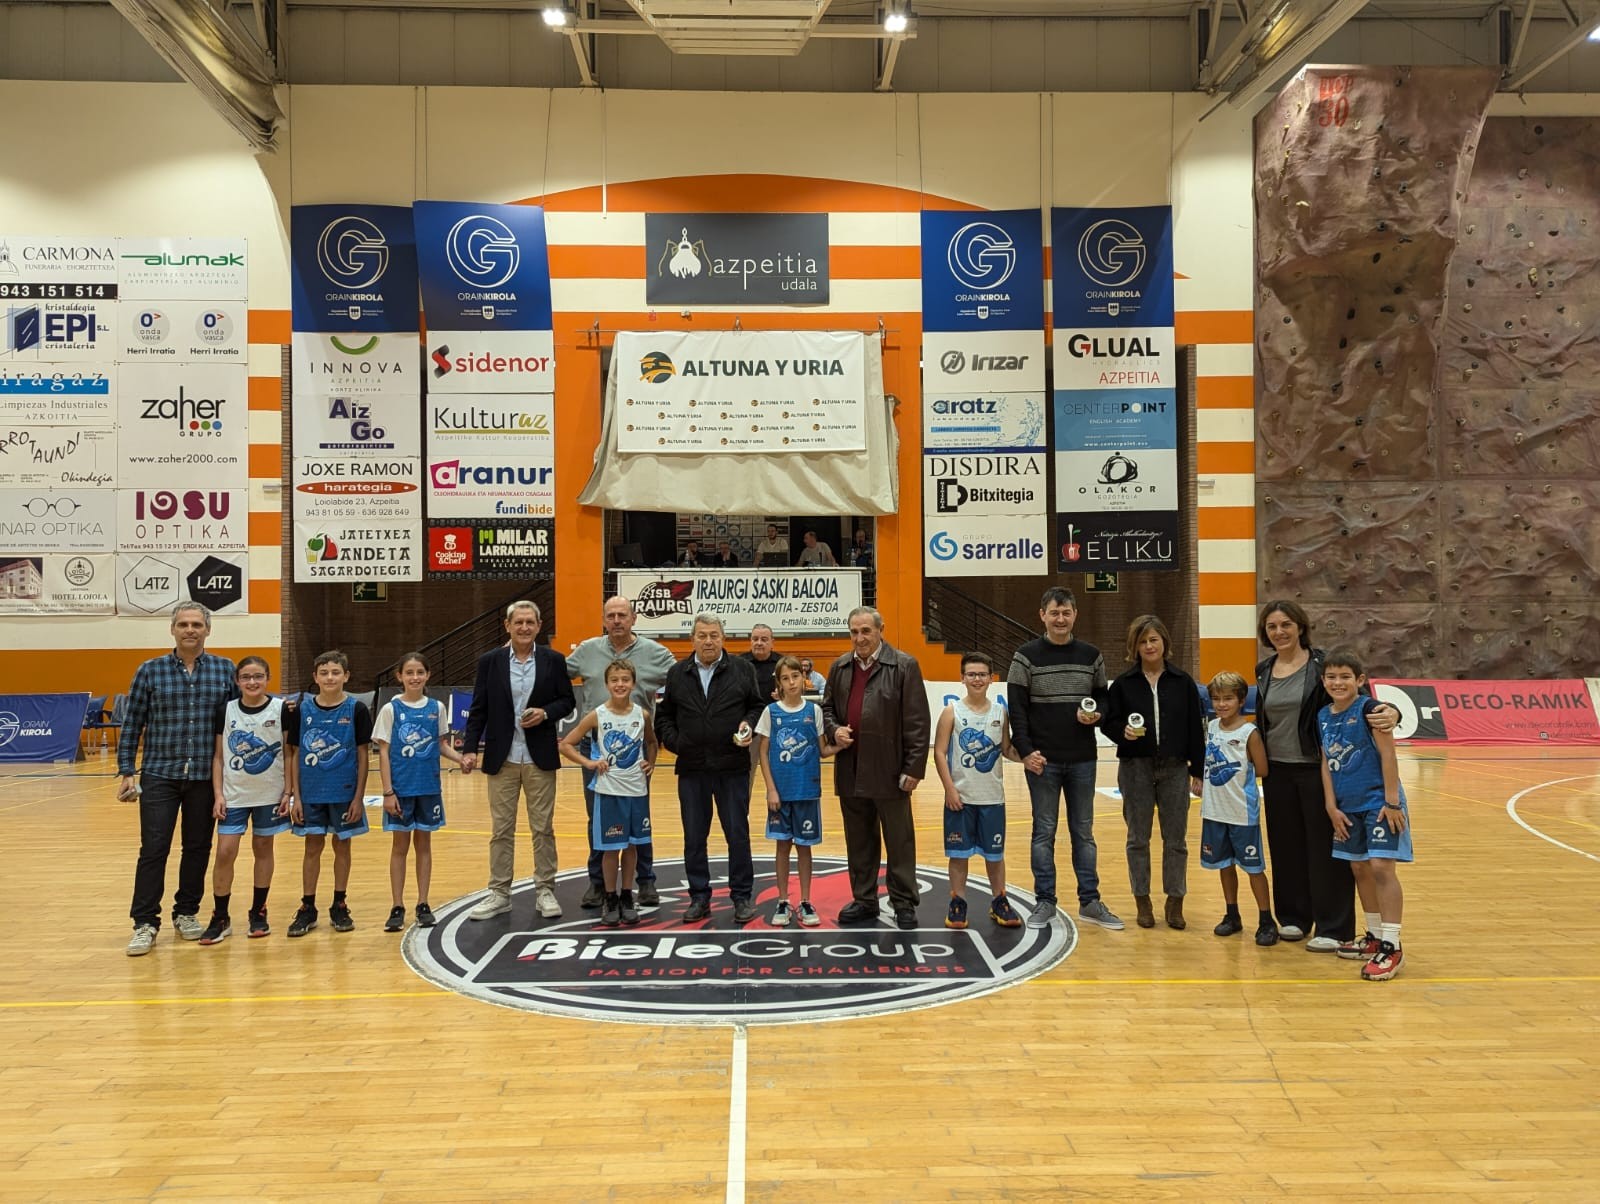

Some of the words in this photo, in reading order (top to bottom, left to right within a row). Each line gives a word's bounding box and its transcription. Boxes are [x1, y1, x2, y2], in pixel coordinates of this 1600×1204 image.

[23, 247, 114, 261] CARMONA
[121, 253, 244, 266] alumak
[712, 252, 818, 290] azpeitia
[1, 285, 30, 296] 943
[39, 286, 65, 296] 151
[75, 286, 104, 296] 514
[781, 279, 817, 290] udala
[46, 314, 95, 341] EPI
[1068, 334, 1160, 357] GLUAL
[310, 362, 402, 374] INNOVA
[456, 352, 549, 373] sidenor
[682, 360, 770, 377] ALTUNA
[775, 360, 788, 376] Y
[793, 359, 844, 376] URIA
[972, 354, 1029, 371] Irizar
[1099, 371, 1160, 384] AZPEITIA
[51, 400, 108, 409] Industriales
[140, 386, 226, 429] zaher
[329, 399, 370, 418] Aiz
[932, 398, 997, 414] aratz
[434, 407, 548, 429] Kulturaz
[351, 421, 385, 441] Go
[129, 454, 237, 463] www.zaher2000.com
[302, 463, 345, 476] JOXE
[351, 463, 413, 476] RAMON
[930, 457, 1040, 476] DISDIRA
[61, 472, 113, 486] Okindegia
[432, 464, 553, 486] aranur
[324, 483, 392, 492] harategia
[1079, 486, 1156, 494] OLAKOR
[970, 488, 1034, 504] Bitxitegia
[135, 491, 230, 520] IOSU
[496, 501, 553, 514] fundibide
[42, 522, 104, 535] OPTIKA
[135, 525, 230, 538] OPTIKA
[340, 530, 411, 540] JATETXEA
[496, 529, 548, 545] MILAR
[435, 551, 467, 559] Cooking
[480, 545, 548, 556] LARRAMENDI
[963, 538, 1043, 559] sarralle
[1087, 540, 1172, 560] ELIKU
[311, 566, 411, 576] SAGARDOTEGIA
[135, 577, 169, 589] LATZ
[197, 576, 232, 589] LATZ
[697, 579, 748, 599] IRAURGI
[752, 578, 789, 599] SASKI
[792, 577, 838, 598] BALOIA
[650, 589, 671, 598] ISB
[697, 603, 740, 614] AZPEITIA
[748, 603, 793, 613] AZKOITIA
[801, 602, 839, 613] ZESTOA
[812, 616, 848, 627] isb@isb.e
[1444, 694, 1588, 710] DECO-RAMIK
[230, 720, 237, 729] 2
[306, 716, 312, 725] 9
[603, 722, 613, 730] 23
[962, 718, 968, 726] 3
[1321, 722, 1328, 730] 7
[20, 728, 52, 737] KIROLA
[516, 938, 955, 963] BieleGroup
[589, 967, 708, 976] PASSION
[721, 966, 773, 975] FOR
[788, 966, 966, 974] CHALLENGES
